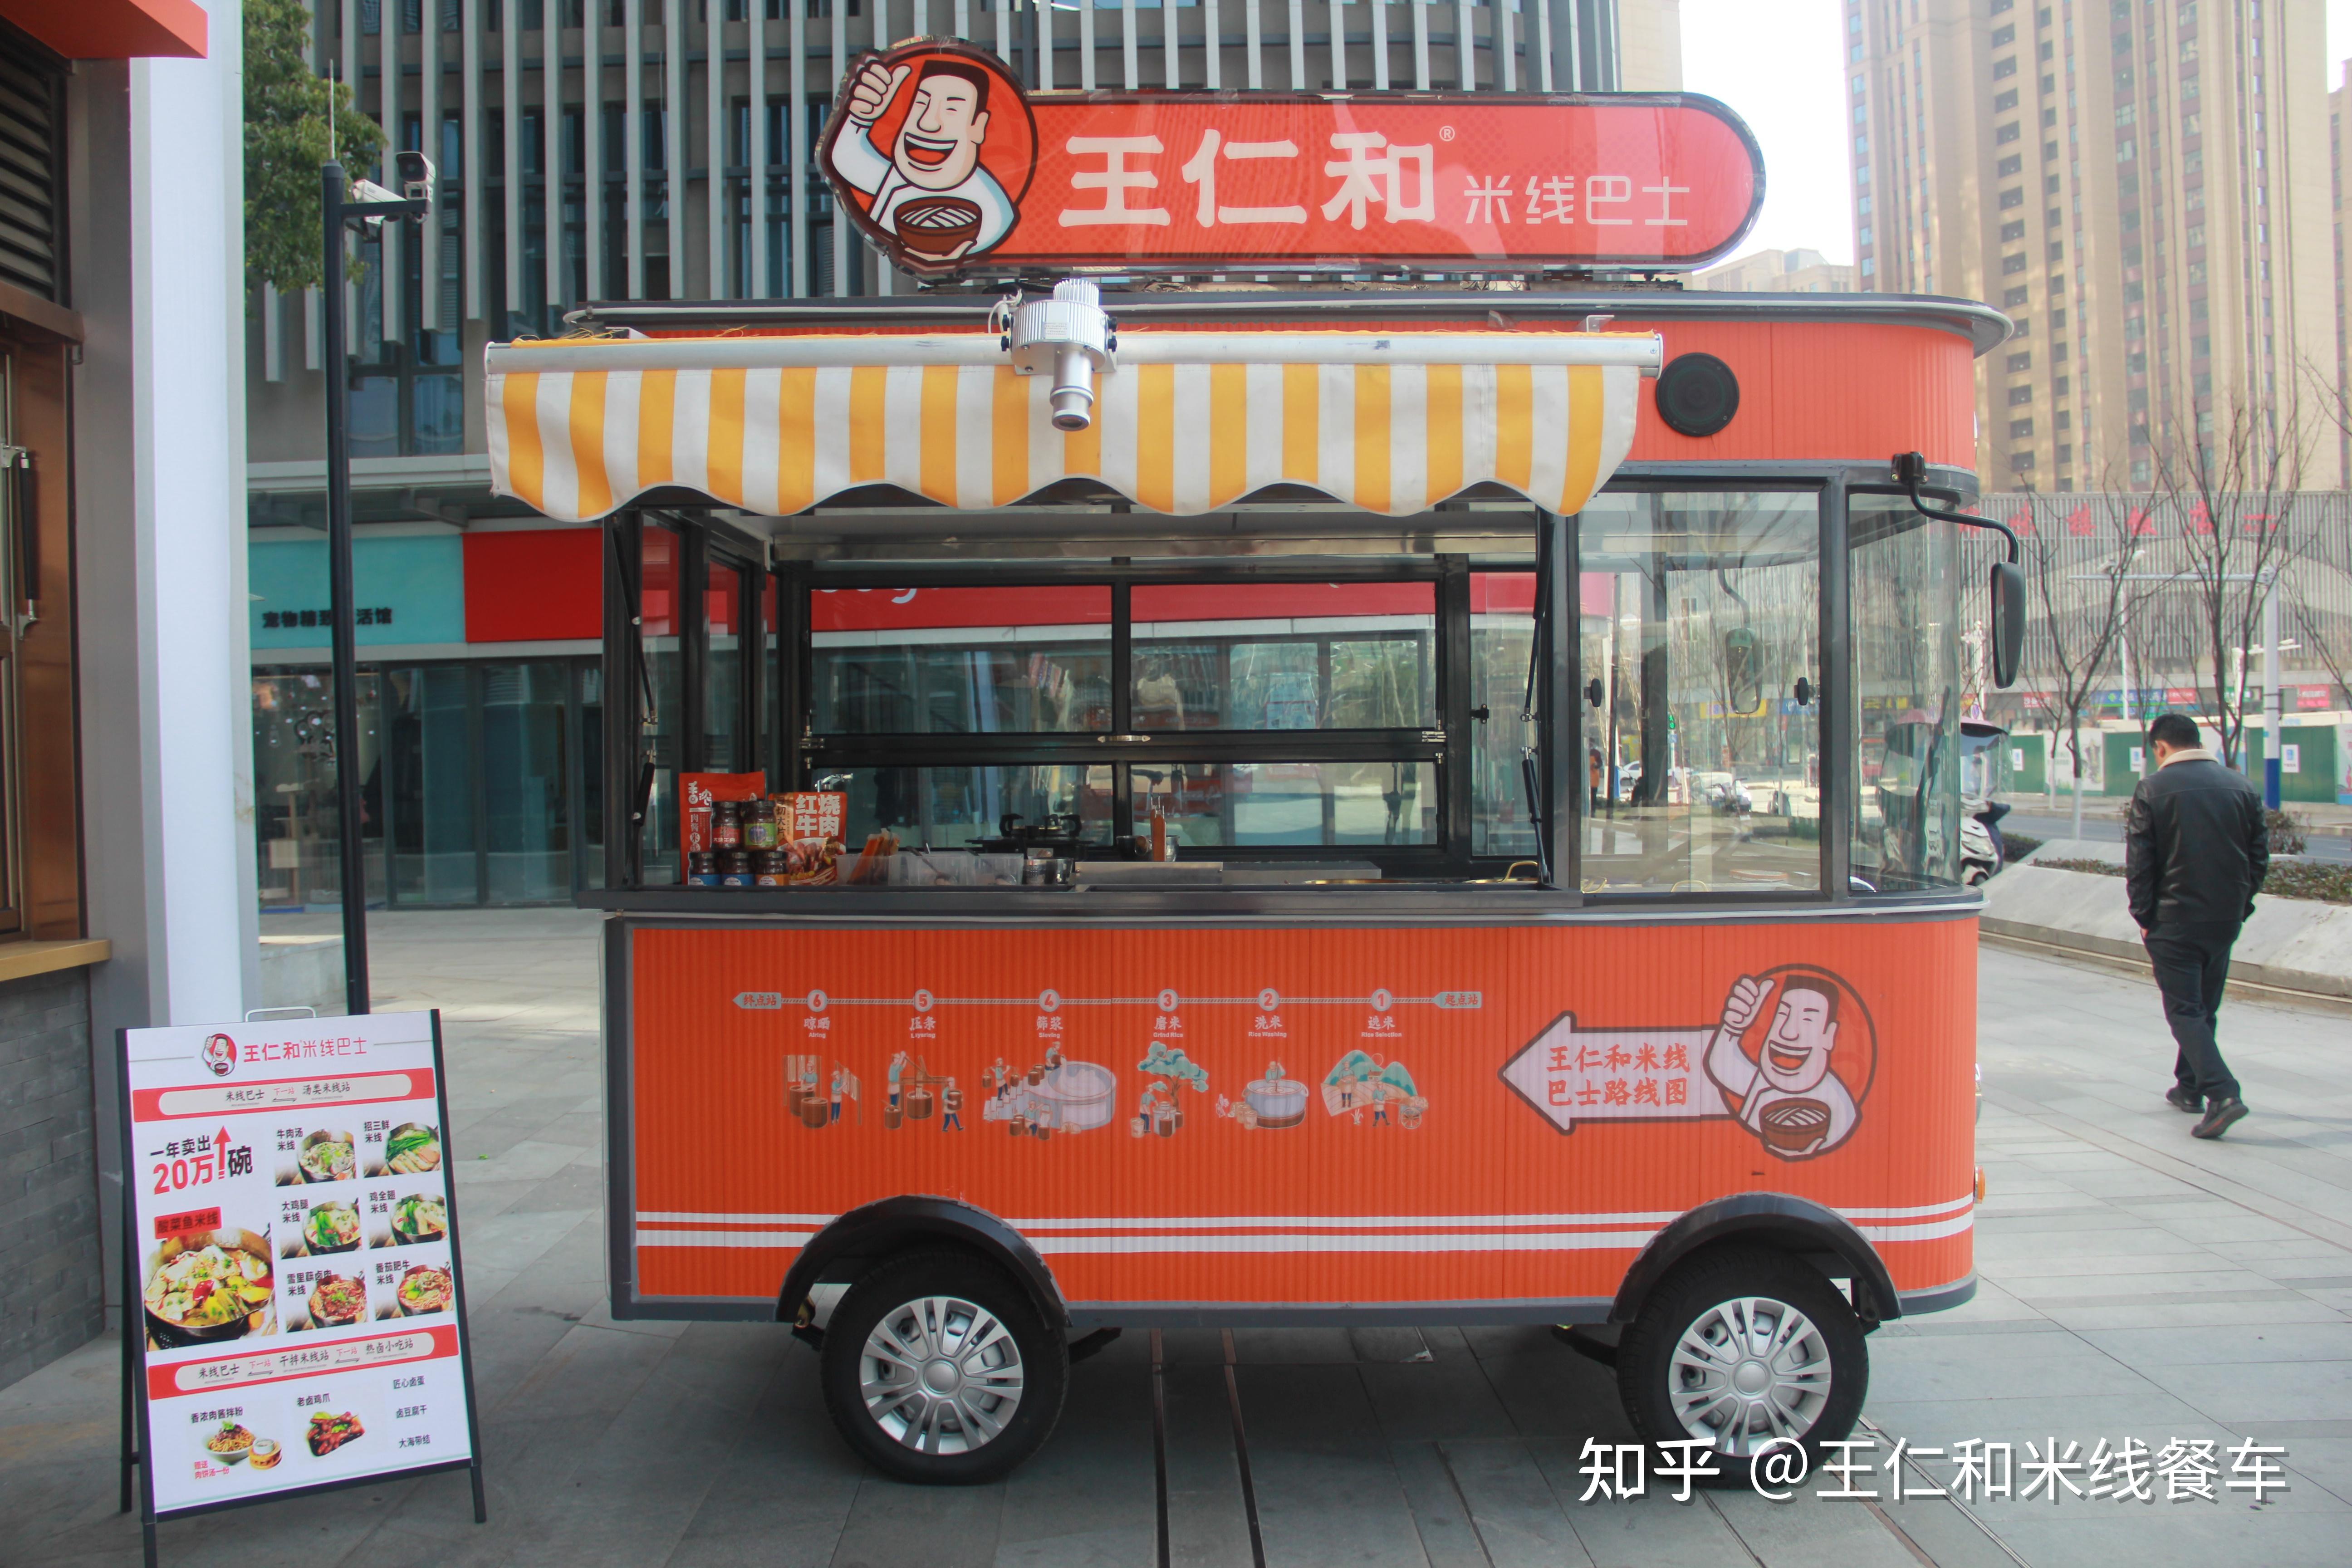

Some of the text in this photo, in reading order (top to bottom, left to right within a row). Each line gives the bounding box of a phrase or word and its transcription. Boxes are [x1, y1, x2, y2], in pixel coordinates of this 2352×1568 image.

[1057, 129, 1690, 230] 王仁和 米线巴士
[263, 608, 392, 628] 宠物精致活馆
[795, 794, 841, 814] 红烧
[795, 815, 840, 836] 牛肉
[744, 994, 777, 1007] 终点站
[813, 994, 822, 1008] 6
[918, 994, 928, 1007] 5
[1044, 994, 1054, 1007] 4
[1163, 994, 1172, 1007] 3
[1264, 993, 1273, 1006] 2
[1377, 993, 1384, 1007] 1
[1444, 994, 1478, 1007] 起点站
[1036, 1016, 1063, 1031] 筛浆
[1154, 1016, 1182, 1030] 磨米
[1255, 1015, 1283, 1029] 洗米
[1368, 1015, 1396, 1030] 选米
[1546, 1043, 1690, 1073] 王仁和米线
[226, 1082, 351, 1102] 米线巴士 下一站 汤类米线站
[1548, 1077, 1688, 1107] 巴士路线图
[277, 1127, 304, 1139] 牛肉汤
[365, 1133, 382, 1143] 米线
[150, 1135, 211, 1157] 一年卖出
[278, 1141, 295, 1151] 米线
[153, 1145, 253, 1195] 20万 碗
[282, 1199, 309, 1211] 大鸡腿
[371, 1203, 388, 1213] 米线
[157, 1211, 218, 1234] 酸菜鱼米线
[283, 1212, 301, 1223] 米线
[376, 1259, 410, 1273] 番茄肥牛
[377, 1274, 394, 1285] 米线
[288, 1285, 306, 1296] 米线
[199, 1363, 240, 1380] 米线巴士
[249, 1359, 271, 1369] 下一站
[279, 1350, 329, 1367] 干拌米线站
[336, 1347, 358, 1357] 下一站
[365, 1338, 414, 1356] 热卤小吃站
[393, 1375, 425, 1389] 匠心卤蛋
[297, 1393, 330, 1407] 老卤鸡爪
[191, 1406, 243, 1423] 香浓肉酱拌粉
[396, 1404, 427, 1418] 卤豆腐干
[399, 1434, 431, 1448] 大海带结
